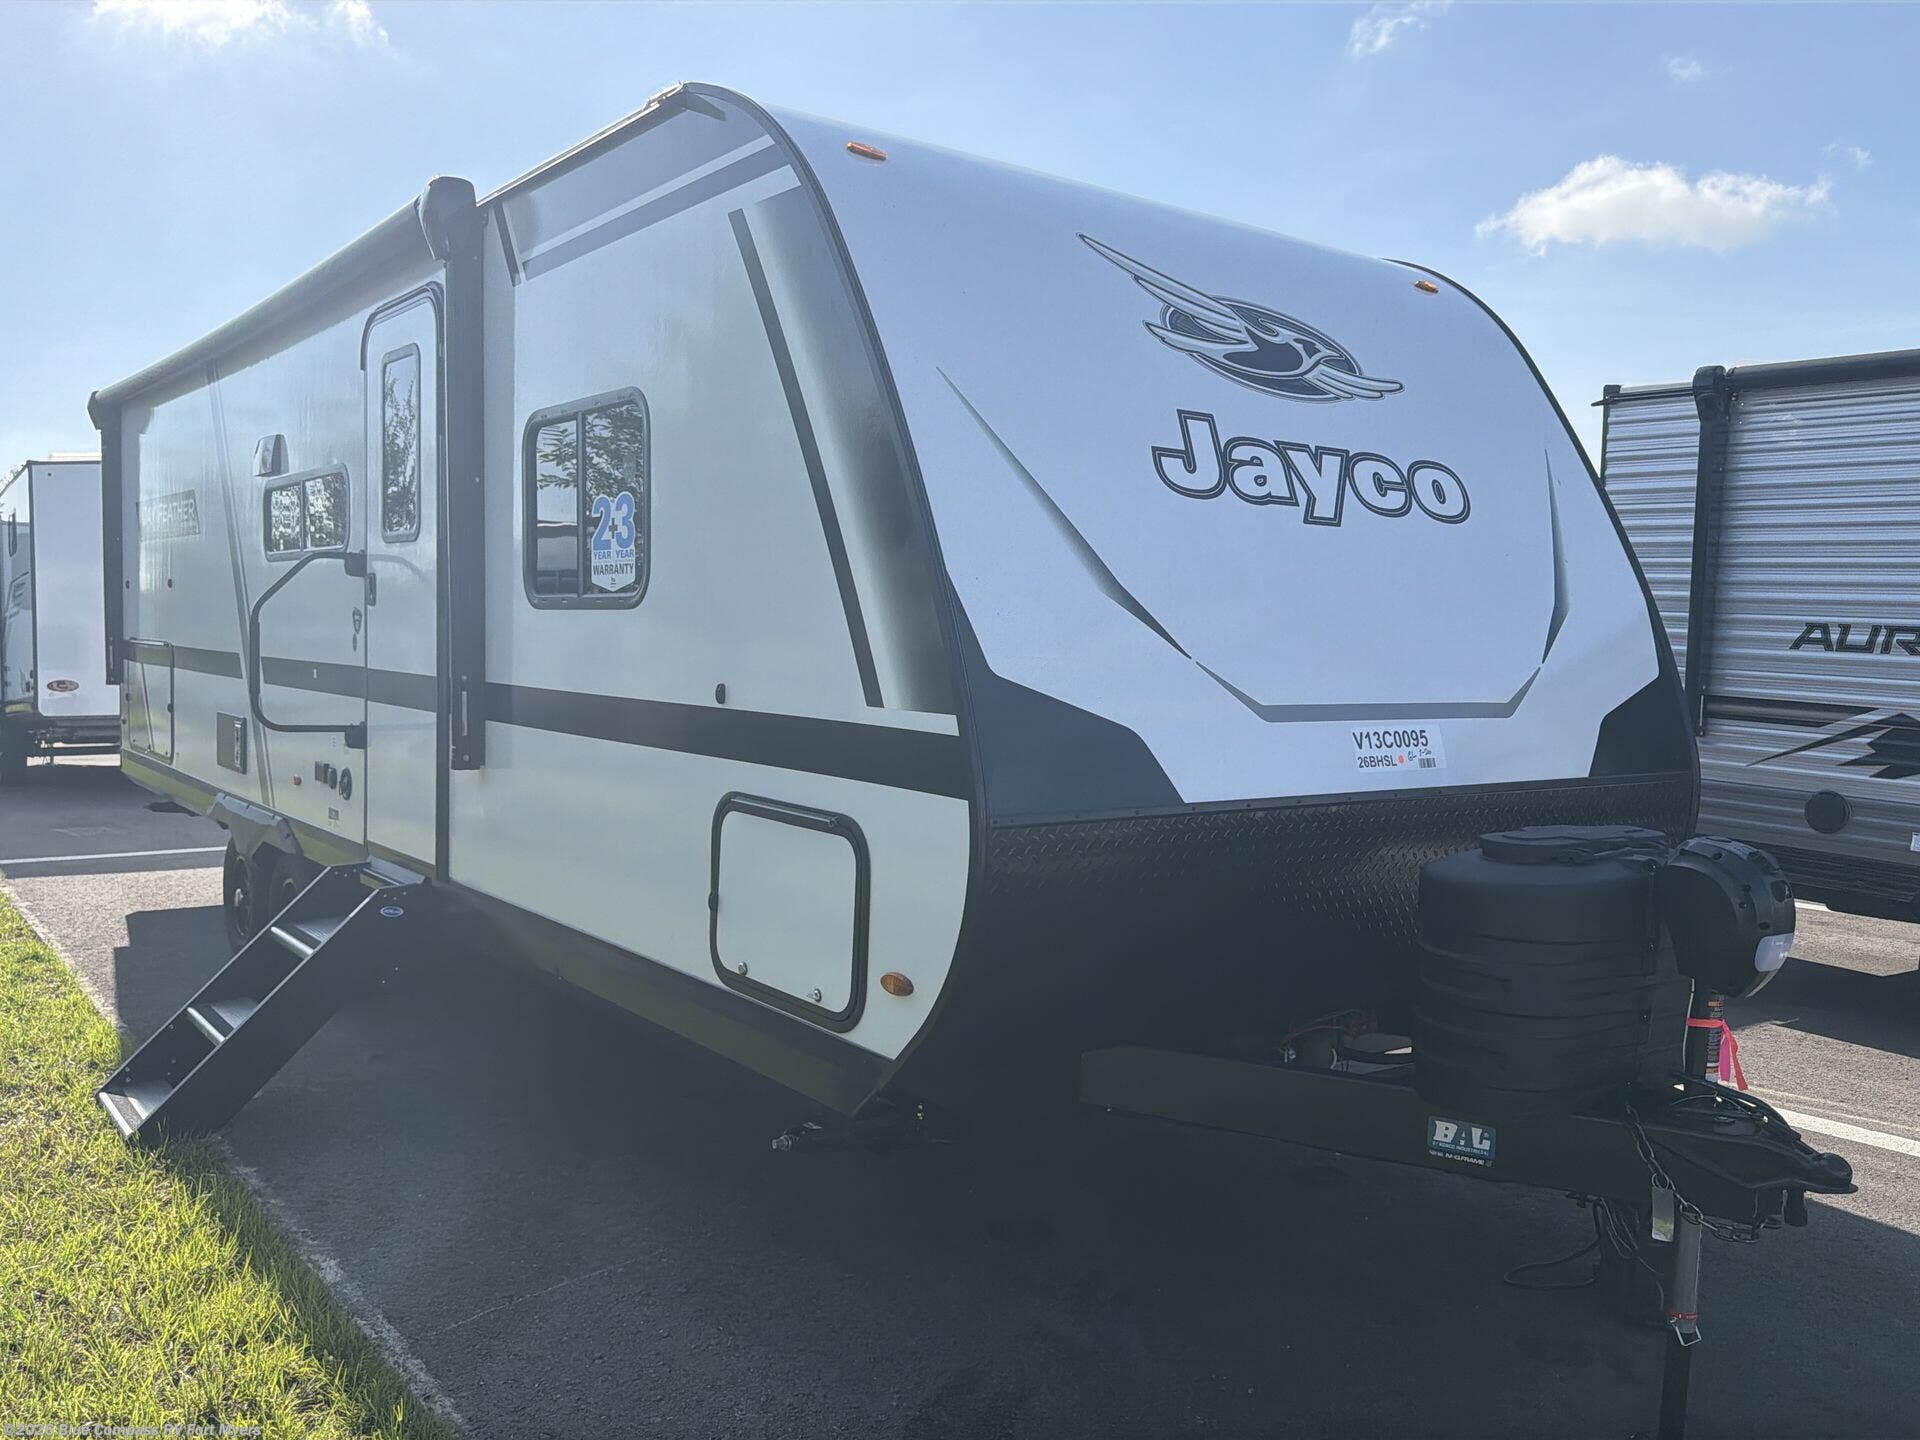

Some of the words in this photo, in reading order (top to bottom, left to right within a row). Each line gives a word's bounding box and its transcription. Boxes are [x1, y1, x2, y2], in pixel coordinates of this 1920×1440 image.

[1151, 408, 1471, 528] Jayco
[158, 499, 195, 523] FEATHER
[593, 550, 612, 560] YEAR
[616, 549, 635, 559] YEAR
[592, 562, 634, 576] WARRANTY
[1352, 729, 1429, 749] V13C0095
[1357, 754, 1398, 768] 26BHSL
[1433, 1120, 1491, 1151] BAL
